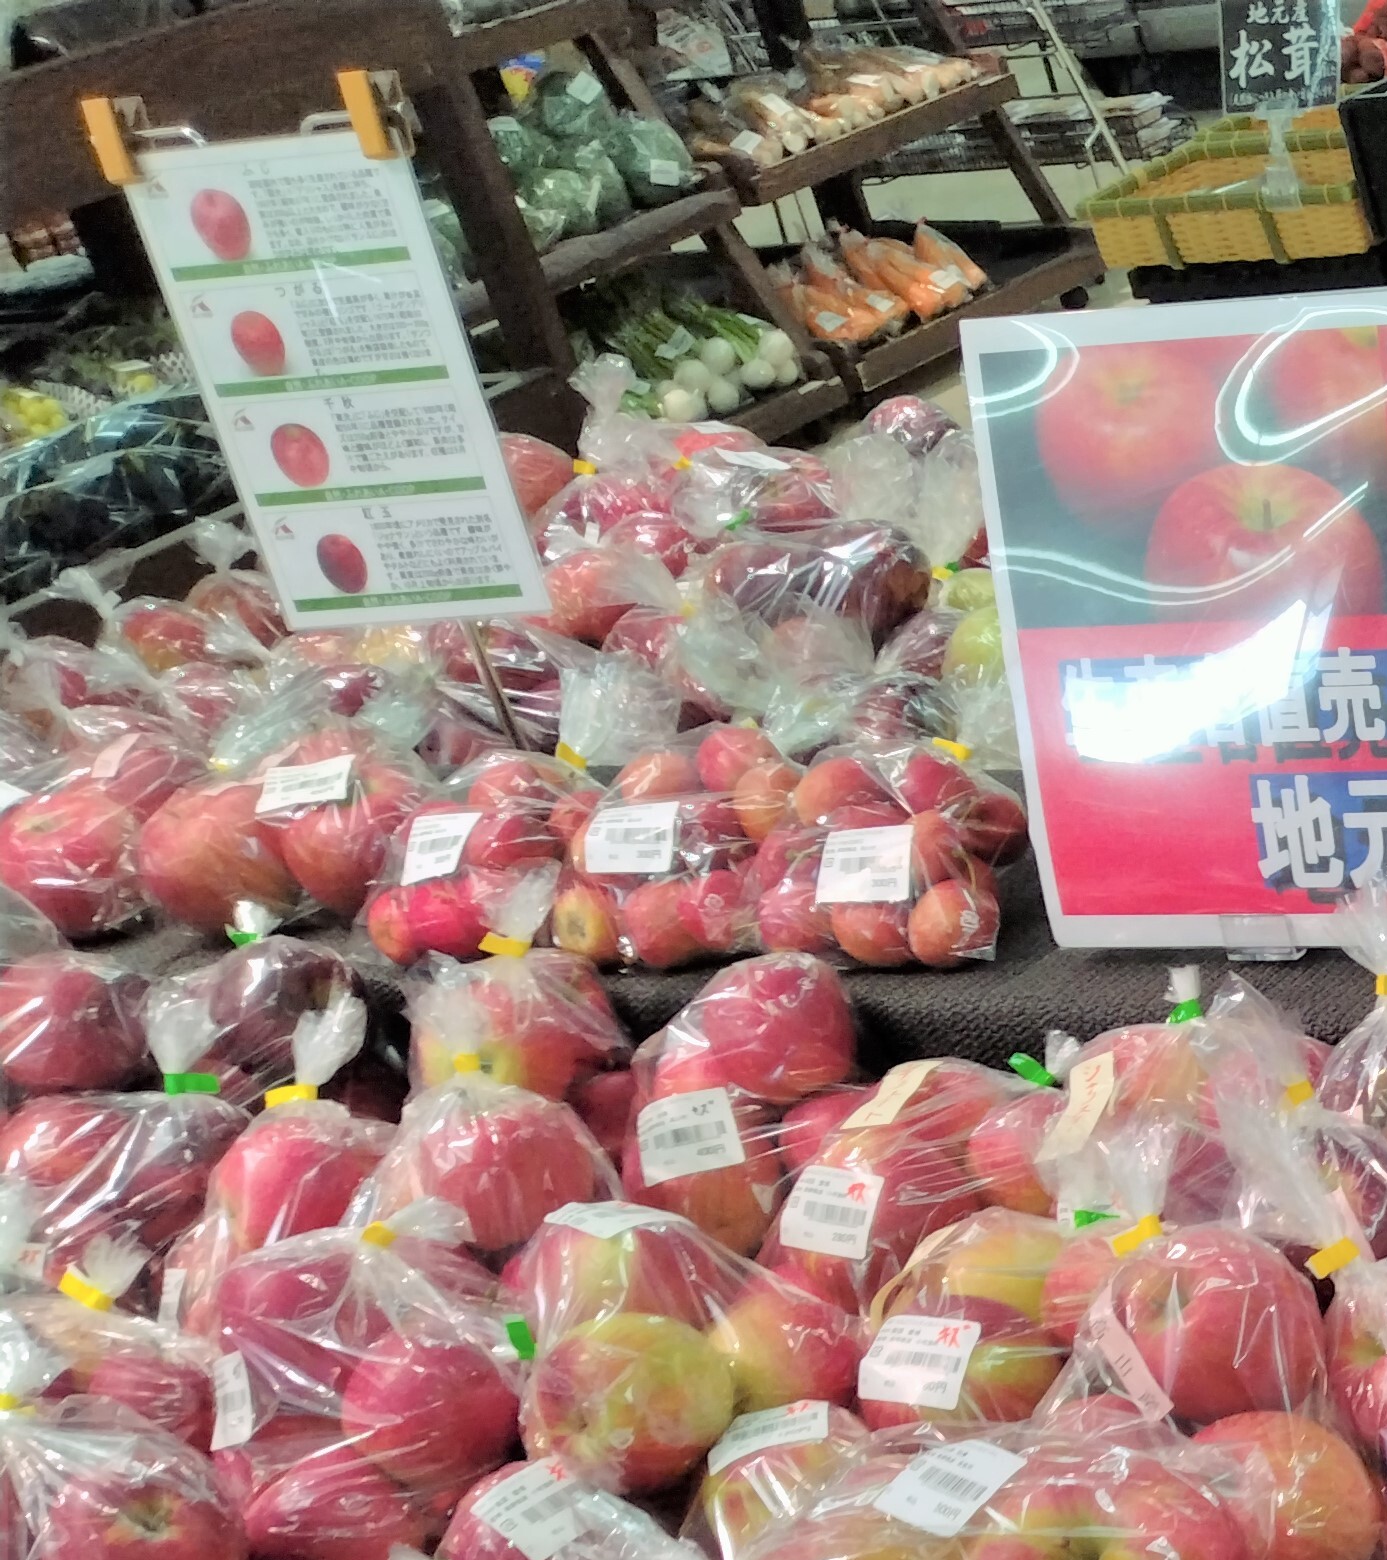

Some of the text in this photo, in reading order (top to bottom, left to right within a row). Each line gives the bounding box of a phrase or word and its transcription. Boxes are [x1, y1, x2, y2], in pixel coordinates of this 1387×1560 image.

[1228, 23, 1320, 90] 松茸
[274, 282, 324, 298] つがる
